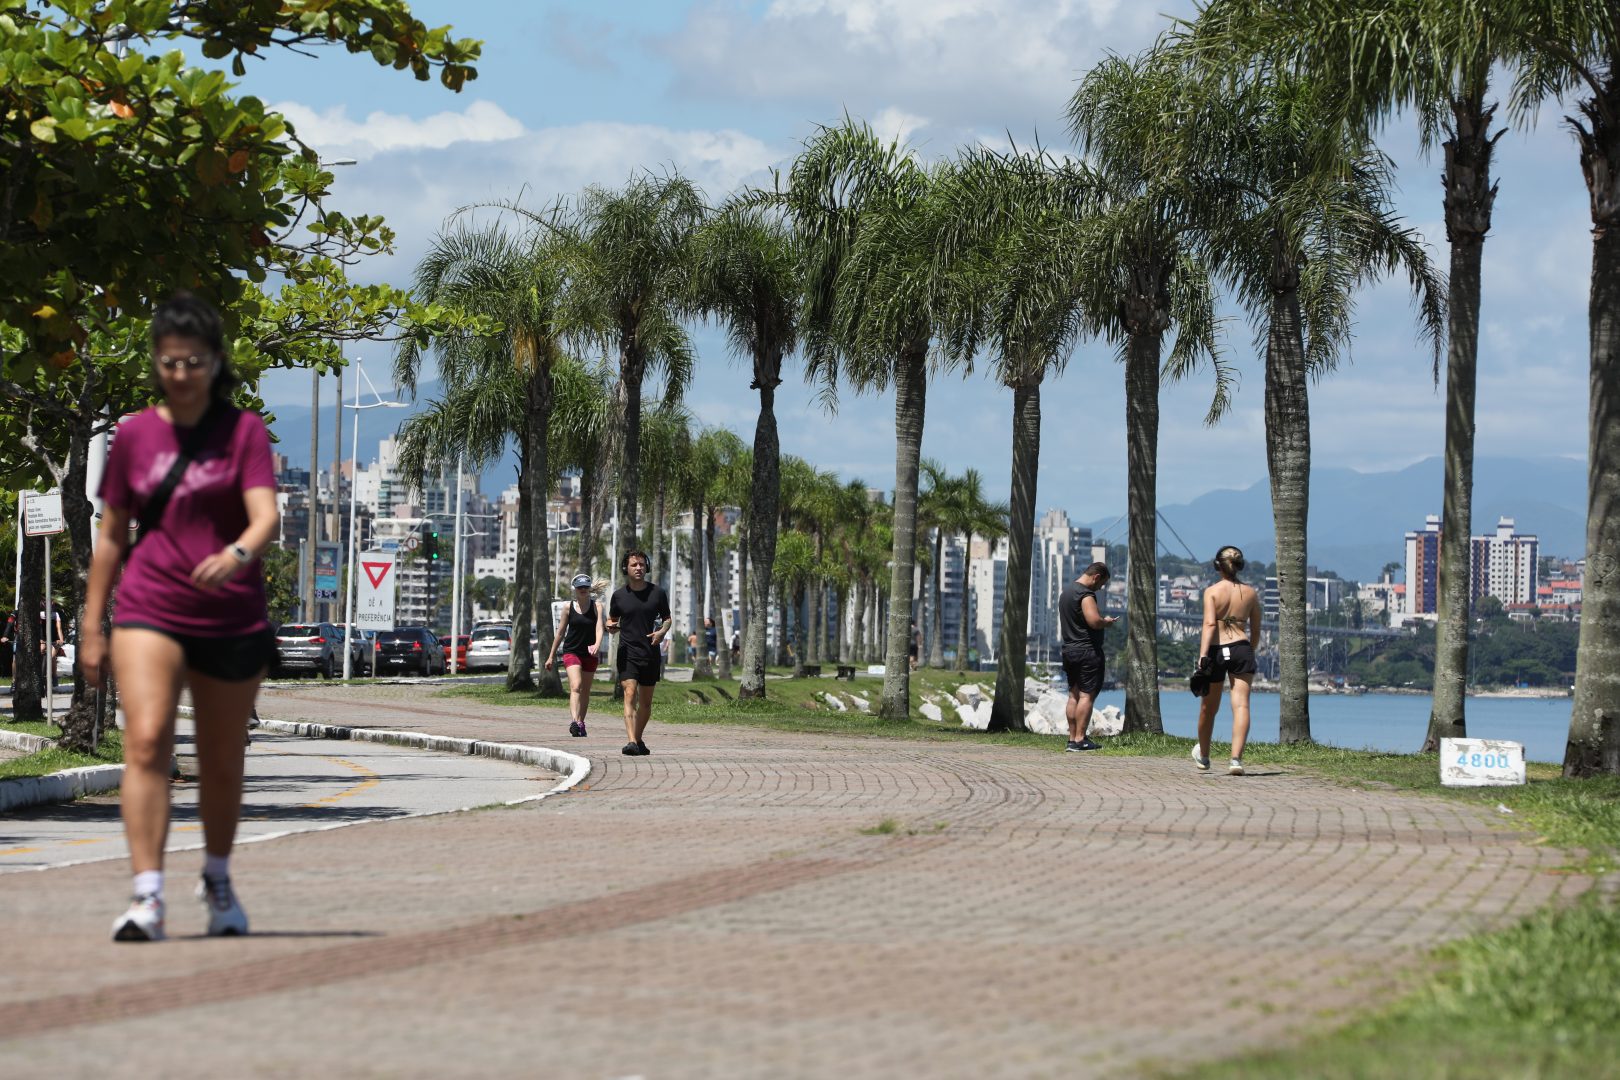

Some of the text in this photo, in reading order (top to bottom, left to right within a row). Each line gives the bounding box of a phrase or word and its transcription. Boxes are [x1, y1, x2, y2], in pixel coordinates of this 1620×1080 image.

[379, 599, 384, 607] A
[358, 611, 392, 622] PREFERÊNCIA
[1456, 752, 1509, 769] 4800
